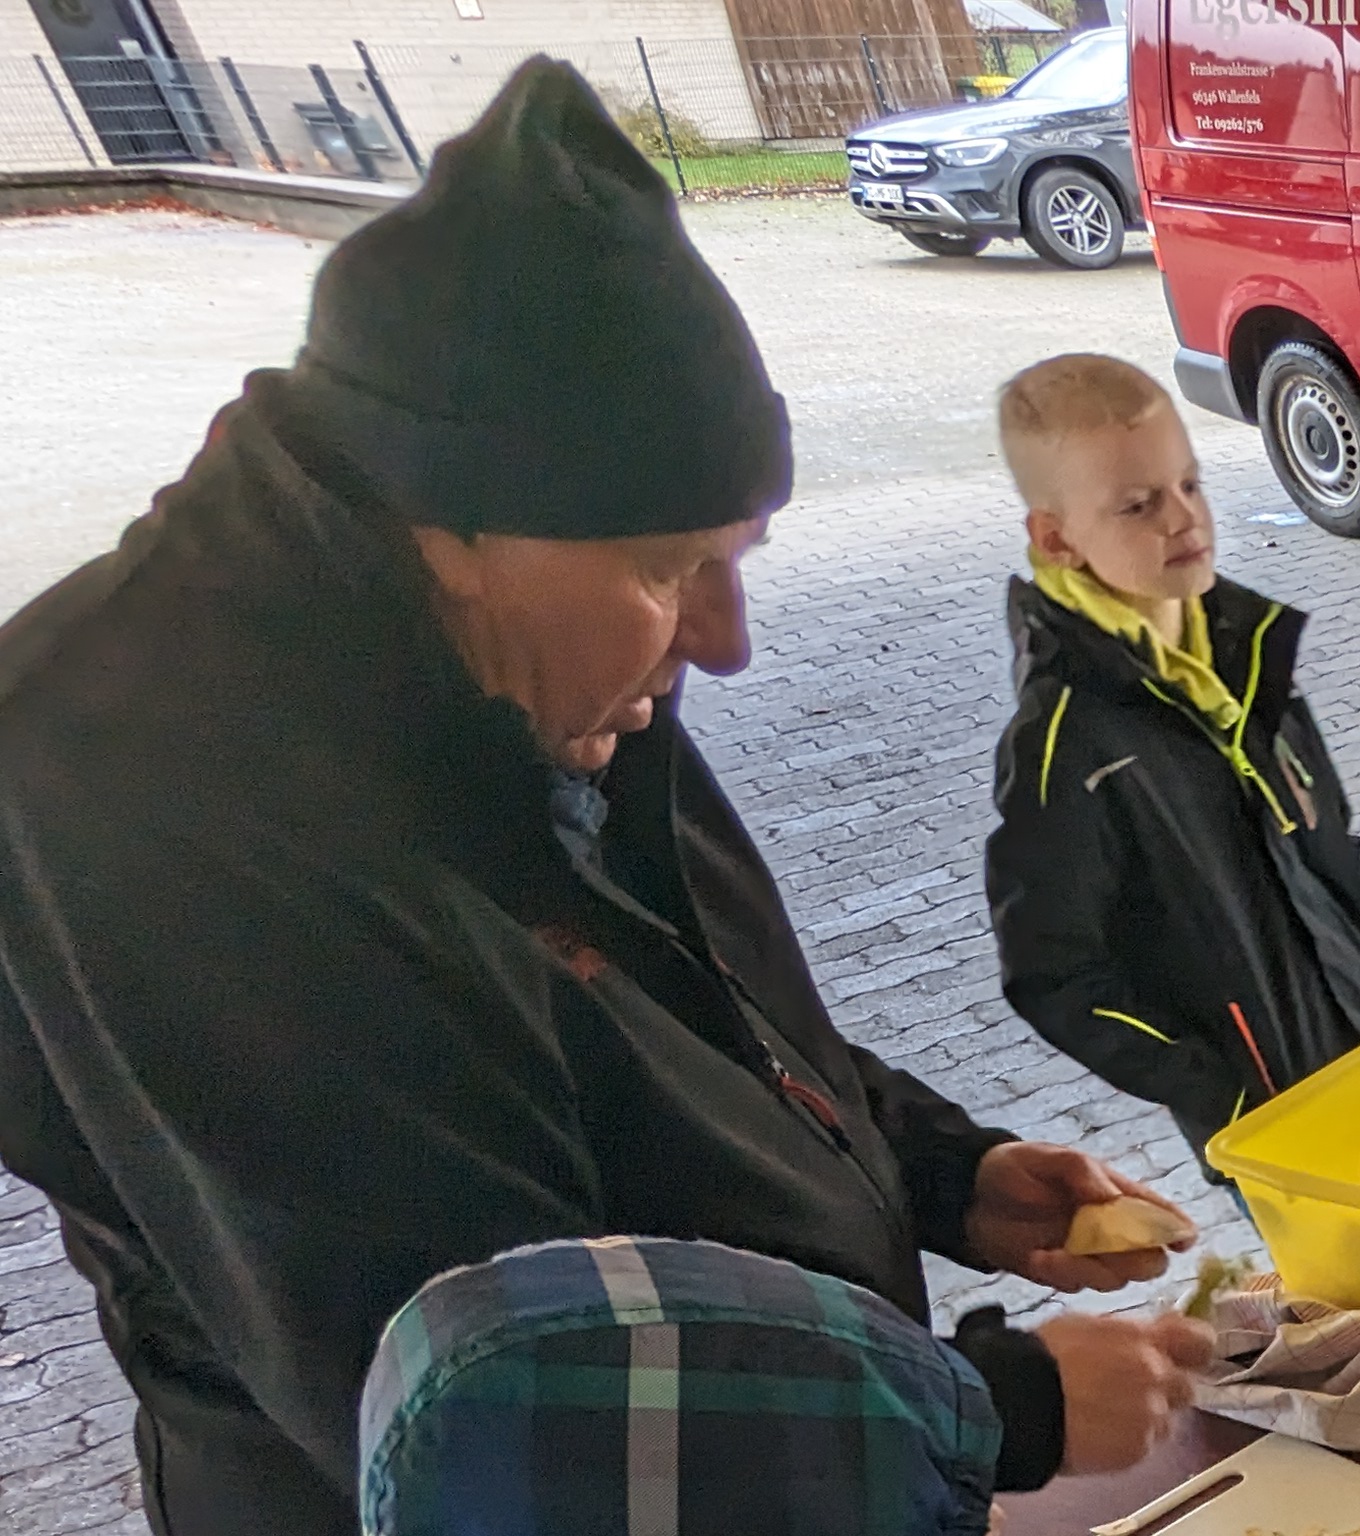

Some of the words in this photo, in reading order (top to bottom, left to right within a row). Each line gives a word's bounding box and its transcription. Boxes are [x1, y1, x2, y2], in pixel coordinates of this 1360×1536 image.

[1189, 61, 1269, 77] Frankenwaldstrasse
[1192, 89, 1218, 106] 96346
[1218, 88, 1261, 105] Wallenfels
[1195, 115, 1213, 130] Tel:
[1214, 116, 1264, 134] 09262/576
